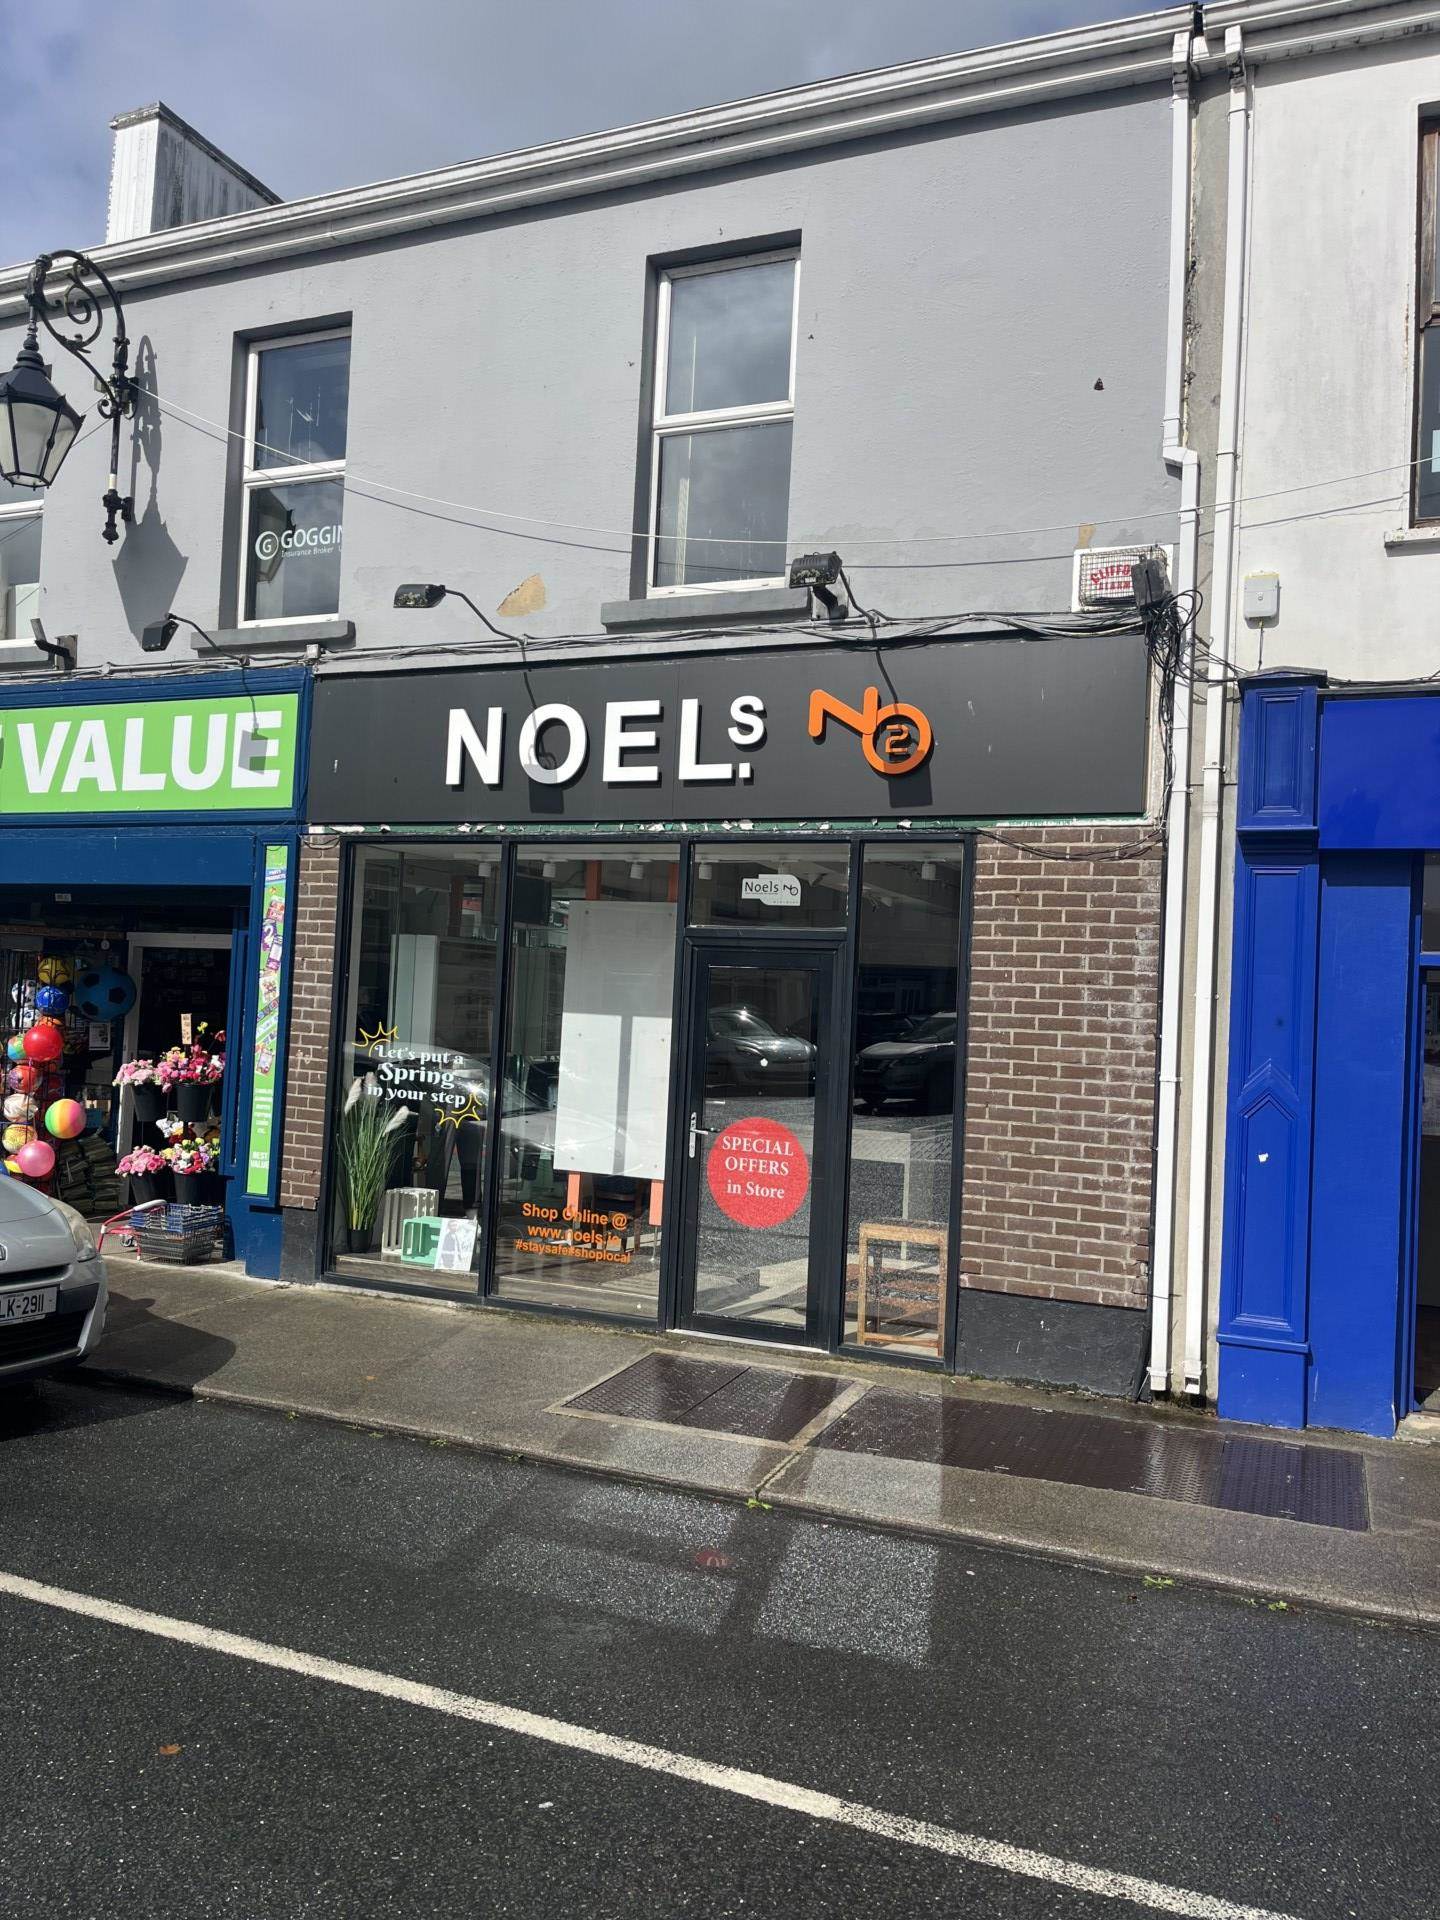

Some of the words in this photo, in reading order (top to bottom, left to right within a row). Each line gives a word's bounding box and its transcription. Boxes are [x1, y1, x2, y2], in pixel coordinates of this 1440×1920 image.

[16, 710, 283, 793] VALUE
[744, 881, 779, 893] Noels
[374, 1044, 416, 1060] Let's
[420, 1051, 451, 1065] put
[453, 1055, 464, 1064] a
[379, 1062, 455, 1089] Spring
[366, 1083, 383, 1097] in
[385, 1087, 428, 1101] your
[430, 1091, 466, 1108] step
[722, 1135, 794, 1156] SPECIAL
[725, 1156, 789, 1176] OFFERS
[726, 1179, 742, 1195] in
[745, 1181, 785, 1199] Store
[522, 1202, 558, 1221] Shop
[562, 1207, 608, 1225] Online
[612, 1212, 627, 1231] @
[527, 1225, 621, 1246] www.noels.ie
